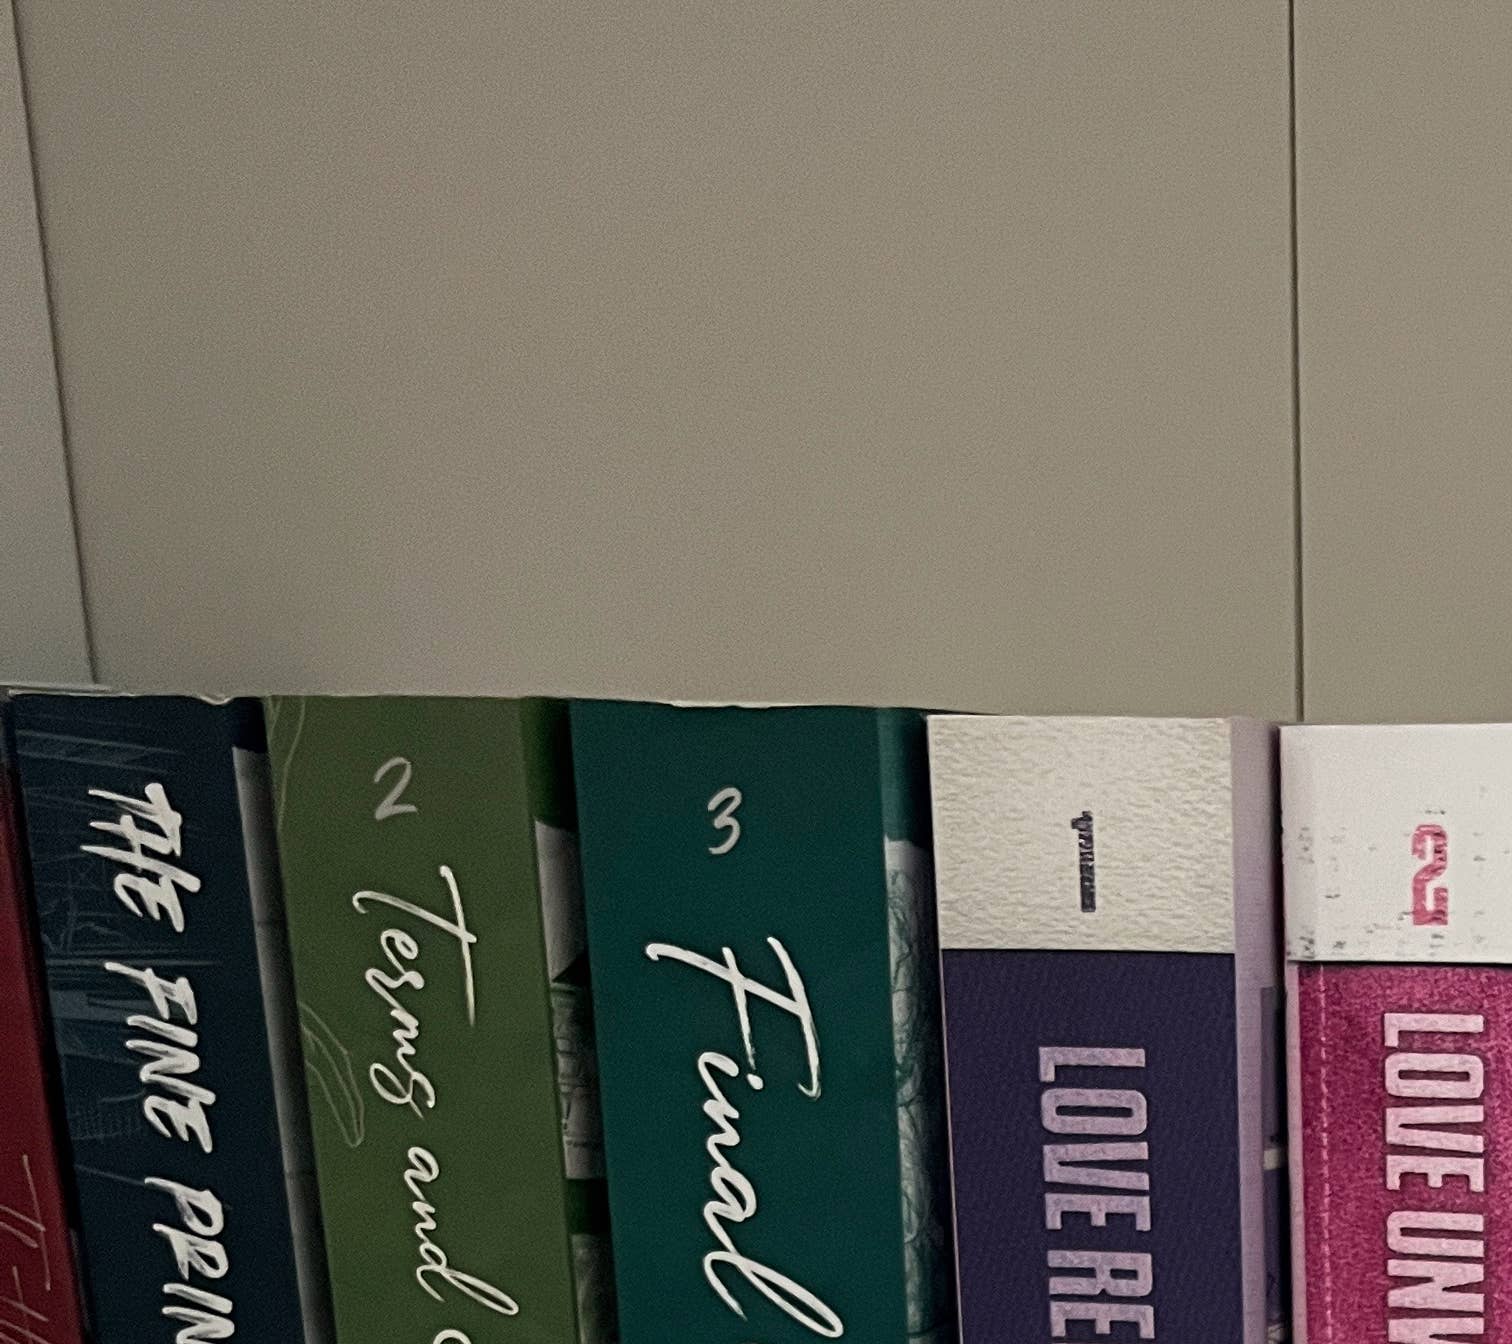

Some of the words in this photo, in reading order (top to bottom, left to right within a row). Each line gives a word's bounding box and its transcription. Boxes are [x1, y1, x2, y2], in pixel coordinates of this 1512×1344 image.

[82, 782, 200, 933] THE
[374, 757, 417, 820] 2
[708, 787, 742, 855] 3
[1071, 810, 1097, 913] 1
[1411, 824, 1449, 926] 2
[104, 962, 215, 1153] FINE
[353, 866, 477, 1119] Terms
[645, 936, 844, 1338] Final
[1039, 1046, 1152, 1232] LOVE
[1383, 1011, 1485, 1193] LOVE
[405, 1146, 519, 1316] and
